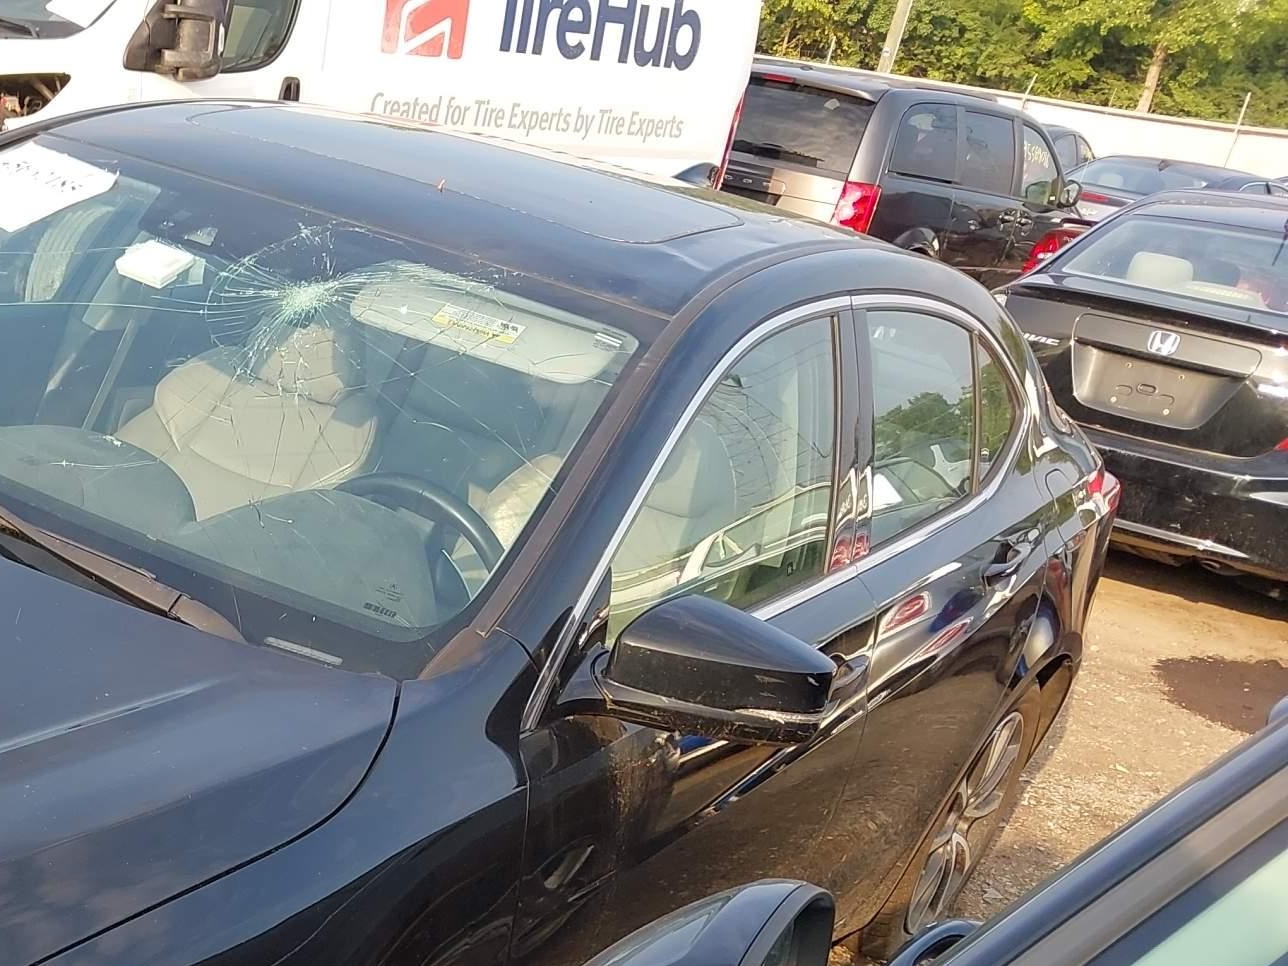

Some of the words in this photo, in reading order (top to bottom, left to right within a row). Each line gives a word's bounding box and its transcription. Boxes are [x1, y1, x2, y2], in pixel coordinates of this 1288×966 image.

[370, 92, 442, 122] Created
[445, 97, 471, 126] for
[474, 99, 505, 128] Tire
[508, 102, 571, 137] Experts
[573, 106, 595, 141] by
[598, 109, 625, 135] Tire
[627, 111, 684, 143] Experts
